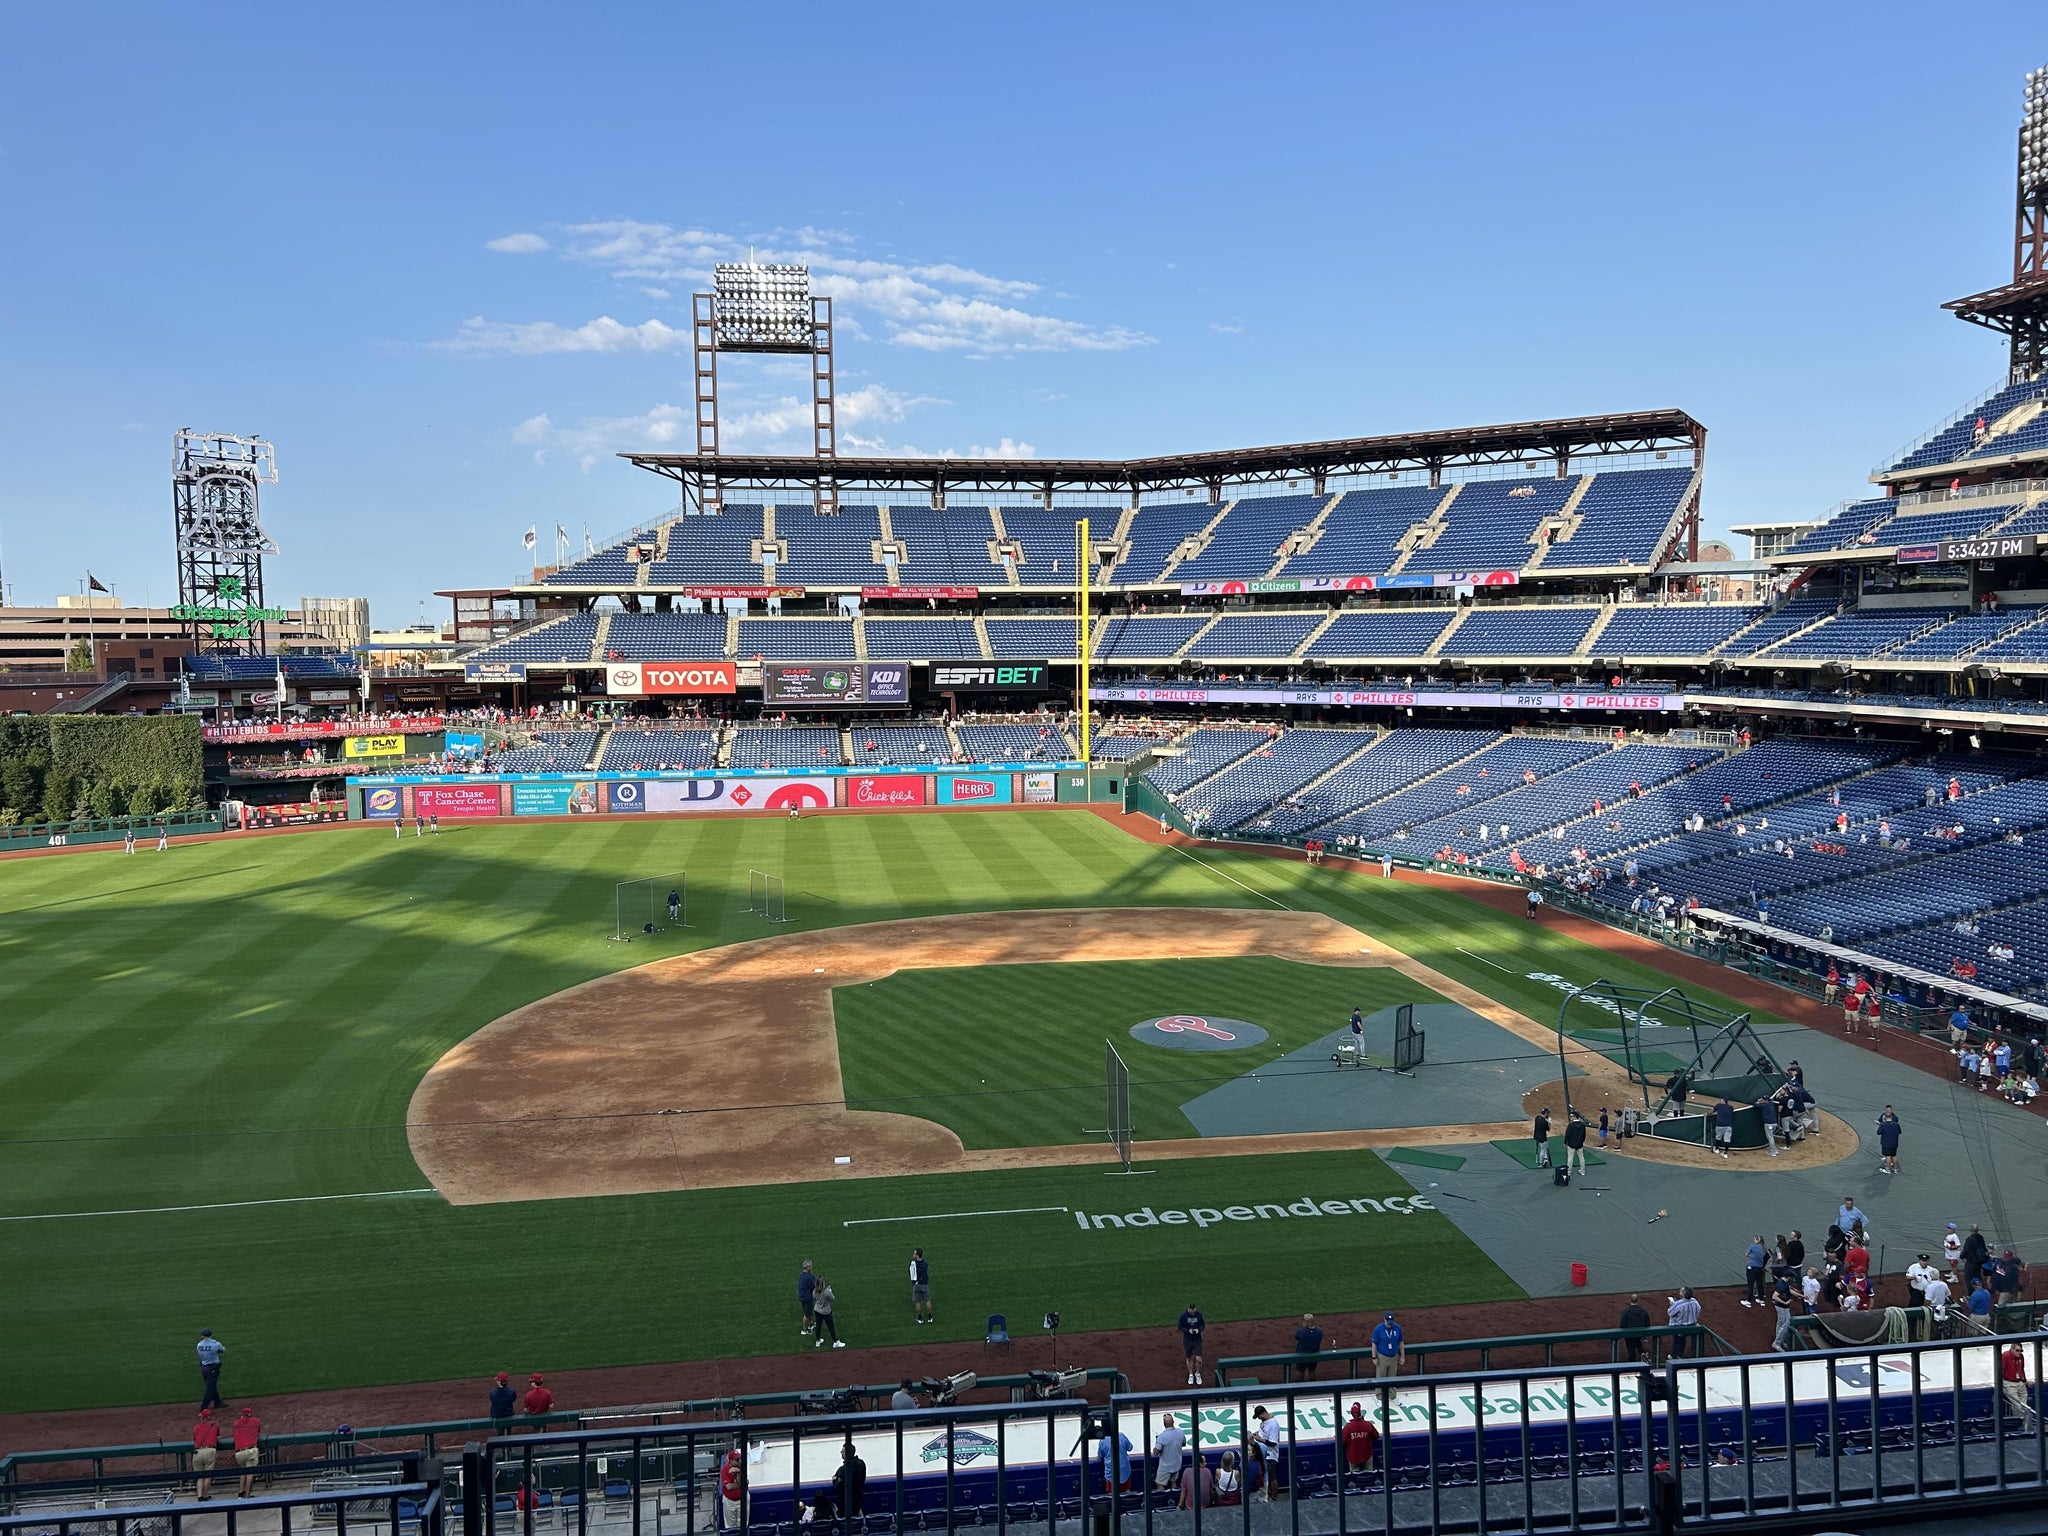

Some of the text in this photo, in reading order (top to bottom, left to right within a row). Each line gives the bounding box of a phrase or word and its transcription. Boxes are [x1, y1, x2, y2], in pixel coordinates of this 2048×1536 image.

[1948, 540, 2022, 559] 5:34:27 PM
[1261, 581, 1296, 591] Citizens
[721, 589, 737, 597] win,
[172, 604, 287, 620] Citizens Bank
[213, 623, 251, 638] Park
[646, 670, 728, 686] TOYOTA
[870, 671, 902, 683] KDI
[934, 667, 1043, 685] ESPN BET
[1154, 691, 1205, 700] PHILLIES
[1296, 693, 1317, 701] RAYS
[1353, 694, 1414, 704] PHILLIES
[1517, 696, 1542, 705] RAYS
[1586, 696, 1660, 708] PHILLIES
[207, 725, 269, 737] #HITTHEBUDS
[334, 720, 391, 731] #HITTHEBUDS
[372, 739, 397, 747] PLAY
[1071, 778, 1084, 787] 330
[435, 790, 484, 799] Fox Chase
[623, 787, 632, 796] R
[734, 791, 747, 799] VS
[857, 783, 915, 802] Chick-fil-A
[956, 784, 990, 795] HERR'S
[370, 792, 397, 808] Hatfield
[435, 798, 465, 806] Cancer
[48, 835, 66, 846] 401
[1074, 1194, 1435, 1230] Independence
[1459, 1387, 1585, 1416] Bank
[1350, 1431, 1369, 1440] STAFF
